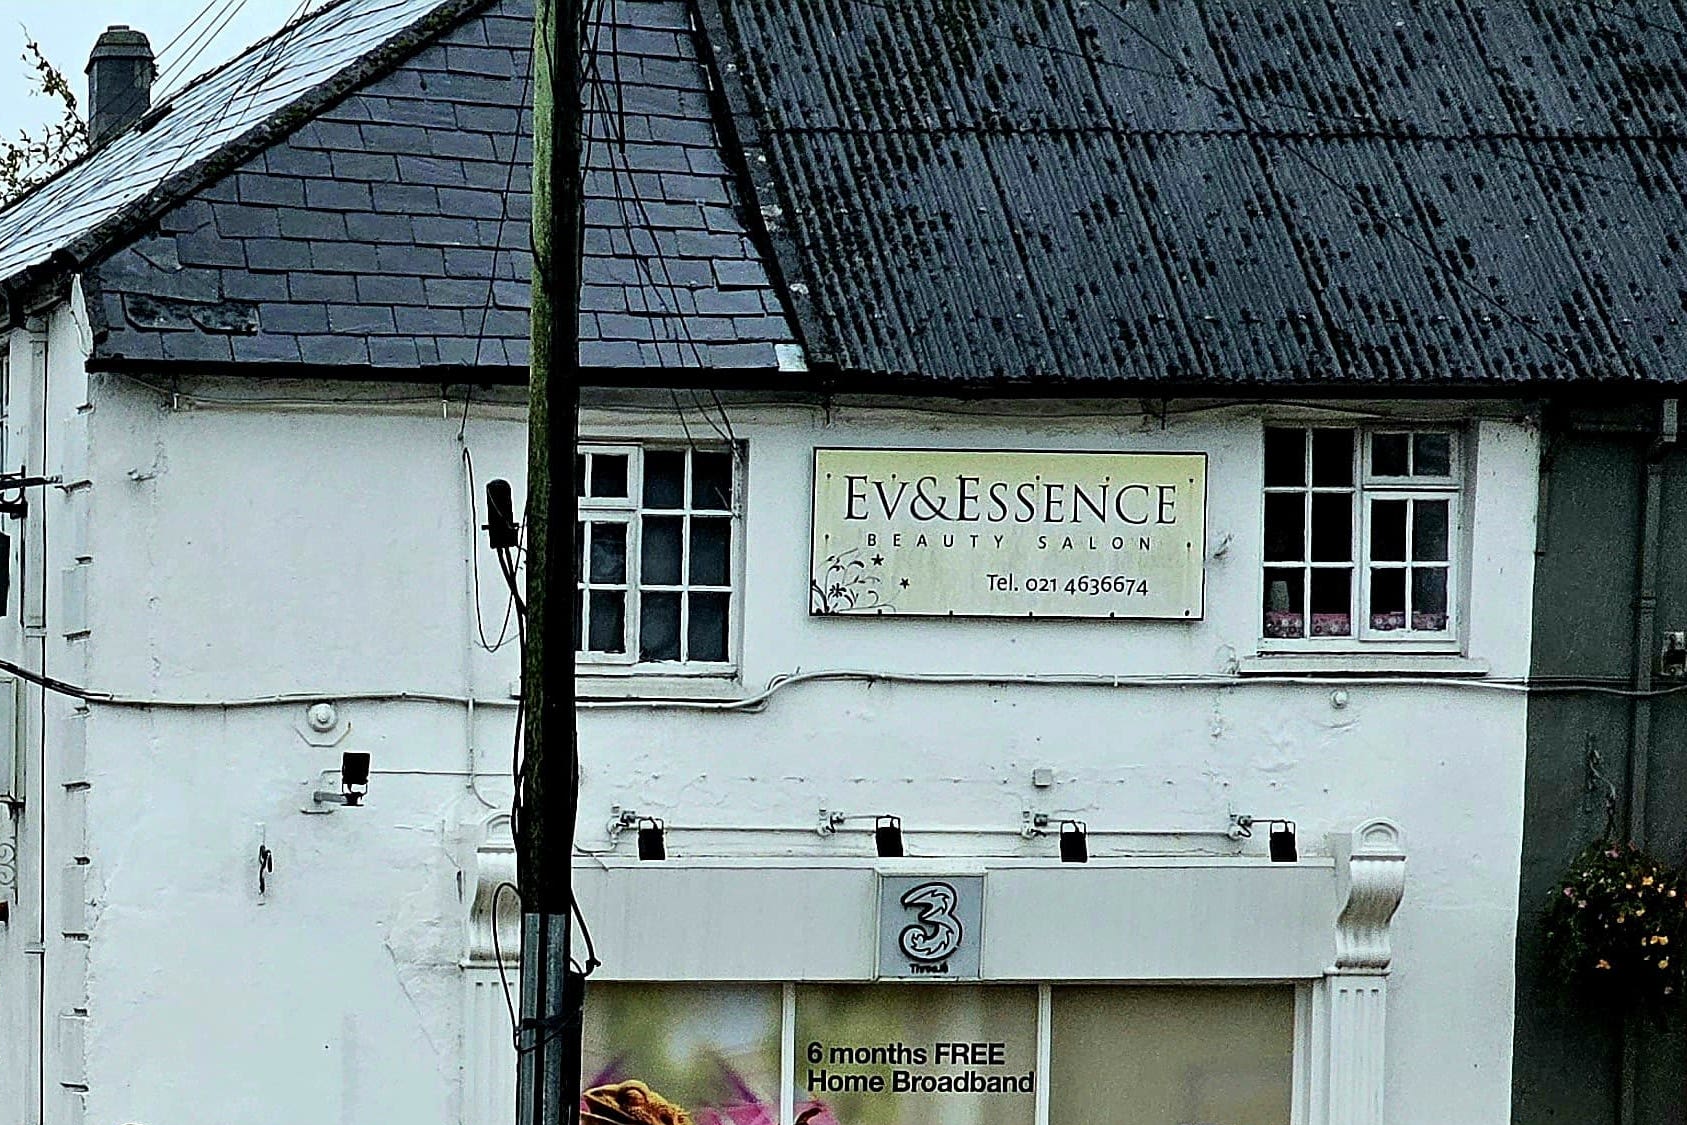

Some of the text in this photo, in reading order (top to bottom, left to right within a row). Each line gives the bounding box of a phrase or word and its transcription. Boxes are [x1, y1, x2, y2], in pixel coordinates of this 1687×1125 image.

[844, 475, 1177, 525] EV&ESSENCE
[868, 533, 1151, 551] BEAUTY SALON
[987, 573, 1149, 596] Tel. 021 4636674
[898, 881, 963, 963] 3
[807, 1041, 1005, 1065] 6 months FREE
[807, 1070, 1035, 1093] Home Broadband
